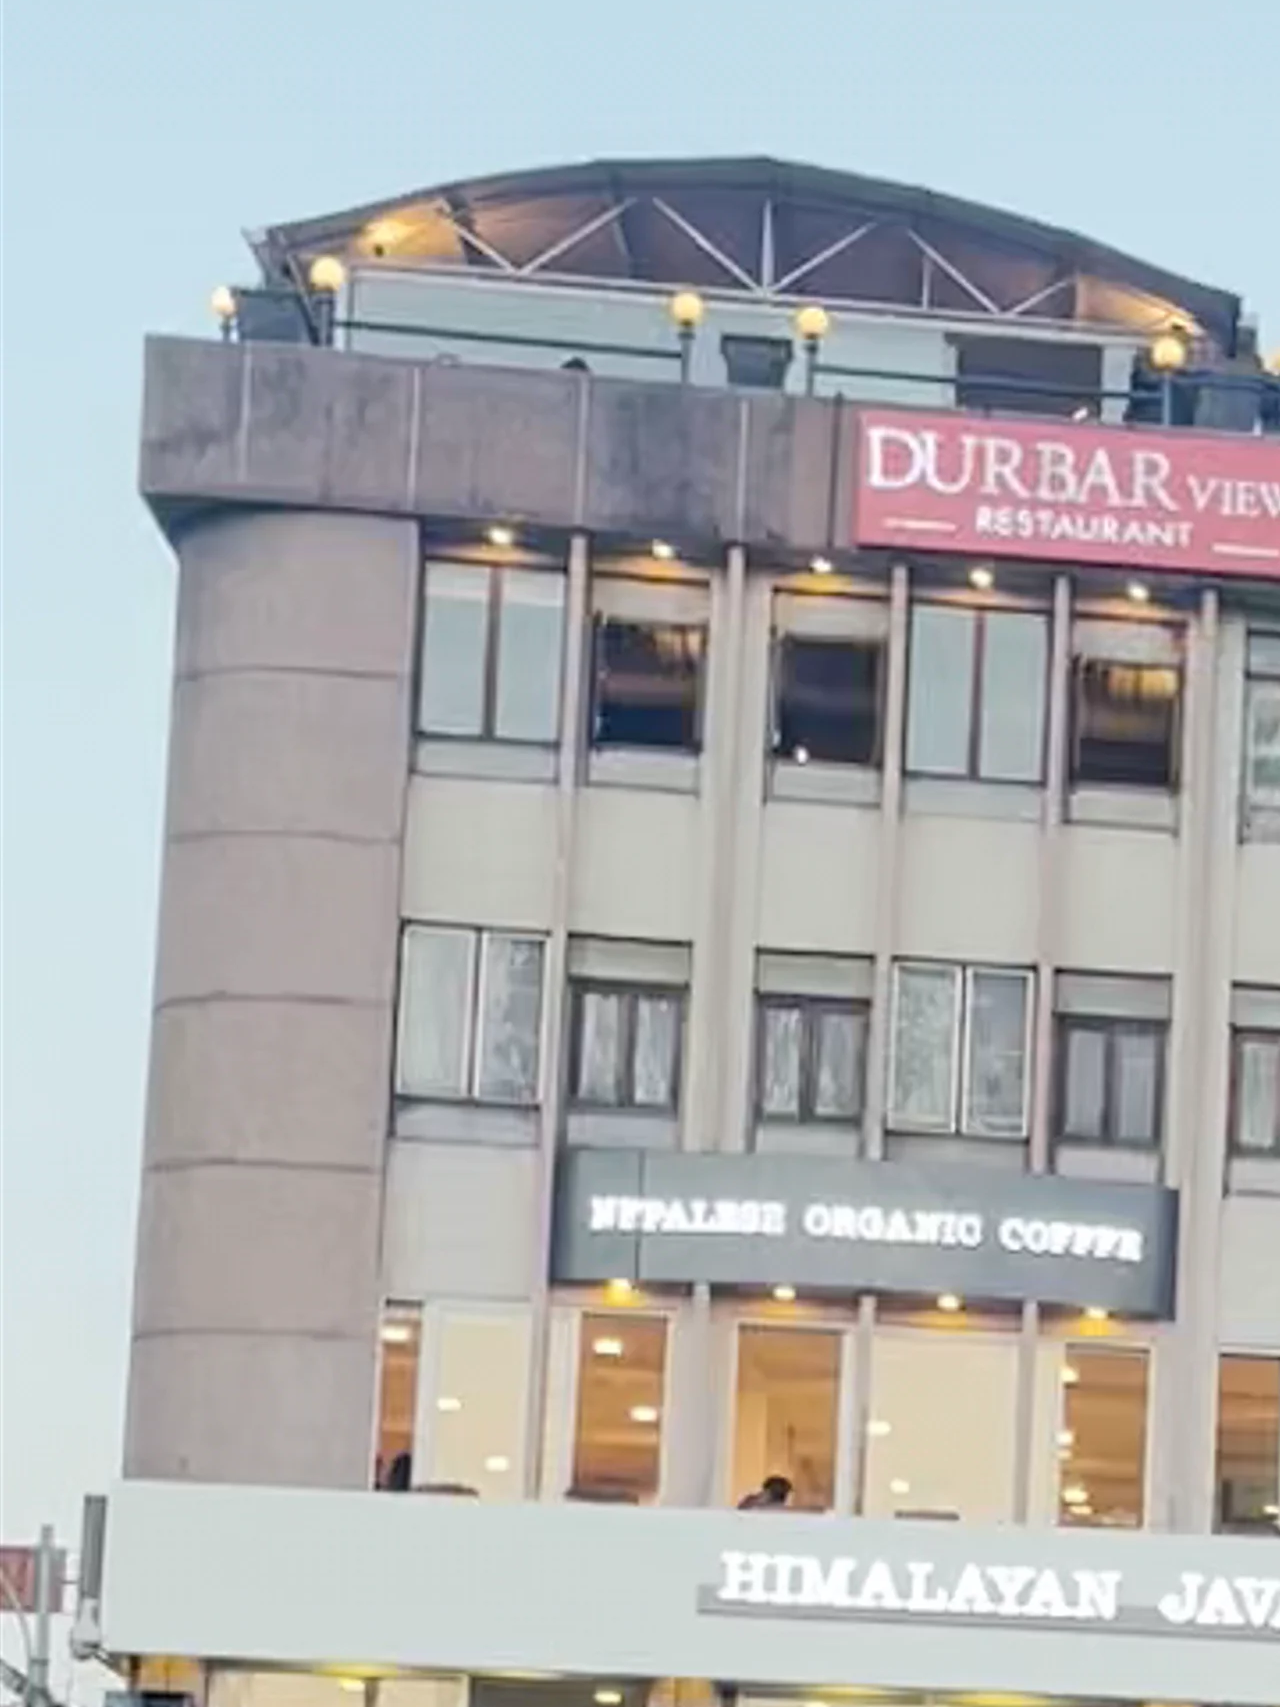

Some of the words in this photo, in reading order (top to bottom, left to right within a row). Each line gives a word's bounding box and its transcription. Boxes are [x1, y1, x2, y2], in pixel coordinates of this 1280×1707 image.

[866, 426, 1180, 511] DURBAR
[975, 505, 1194, 547] RESTAURANT
[804, 1203, 982, 1247] ORGANIC
[717, 1550, 1121, 1620] HIMALAYAN
